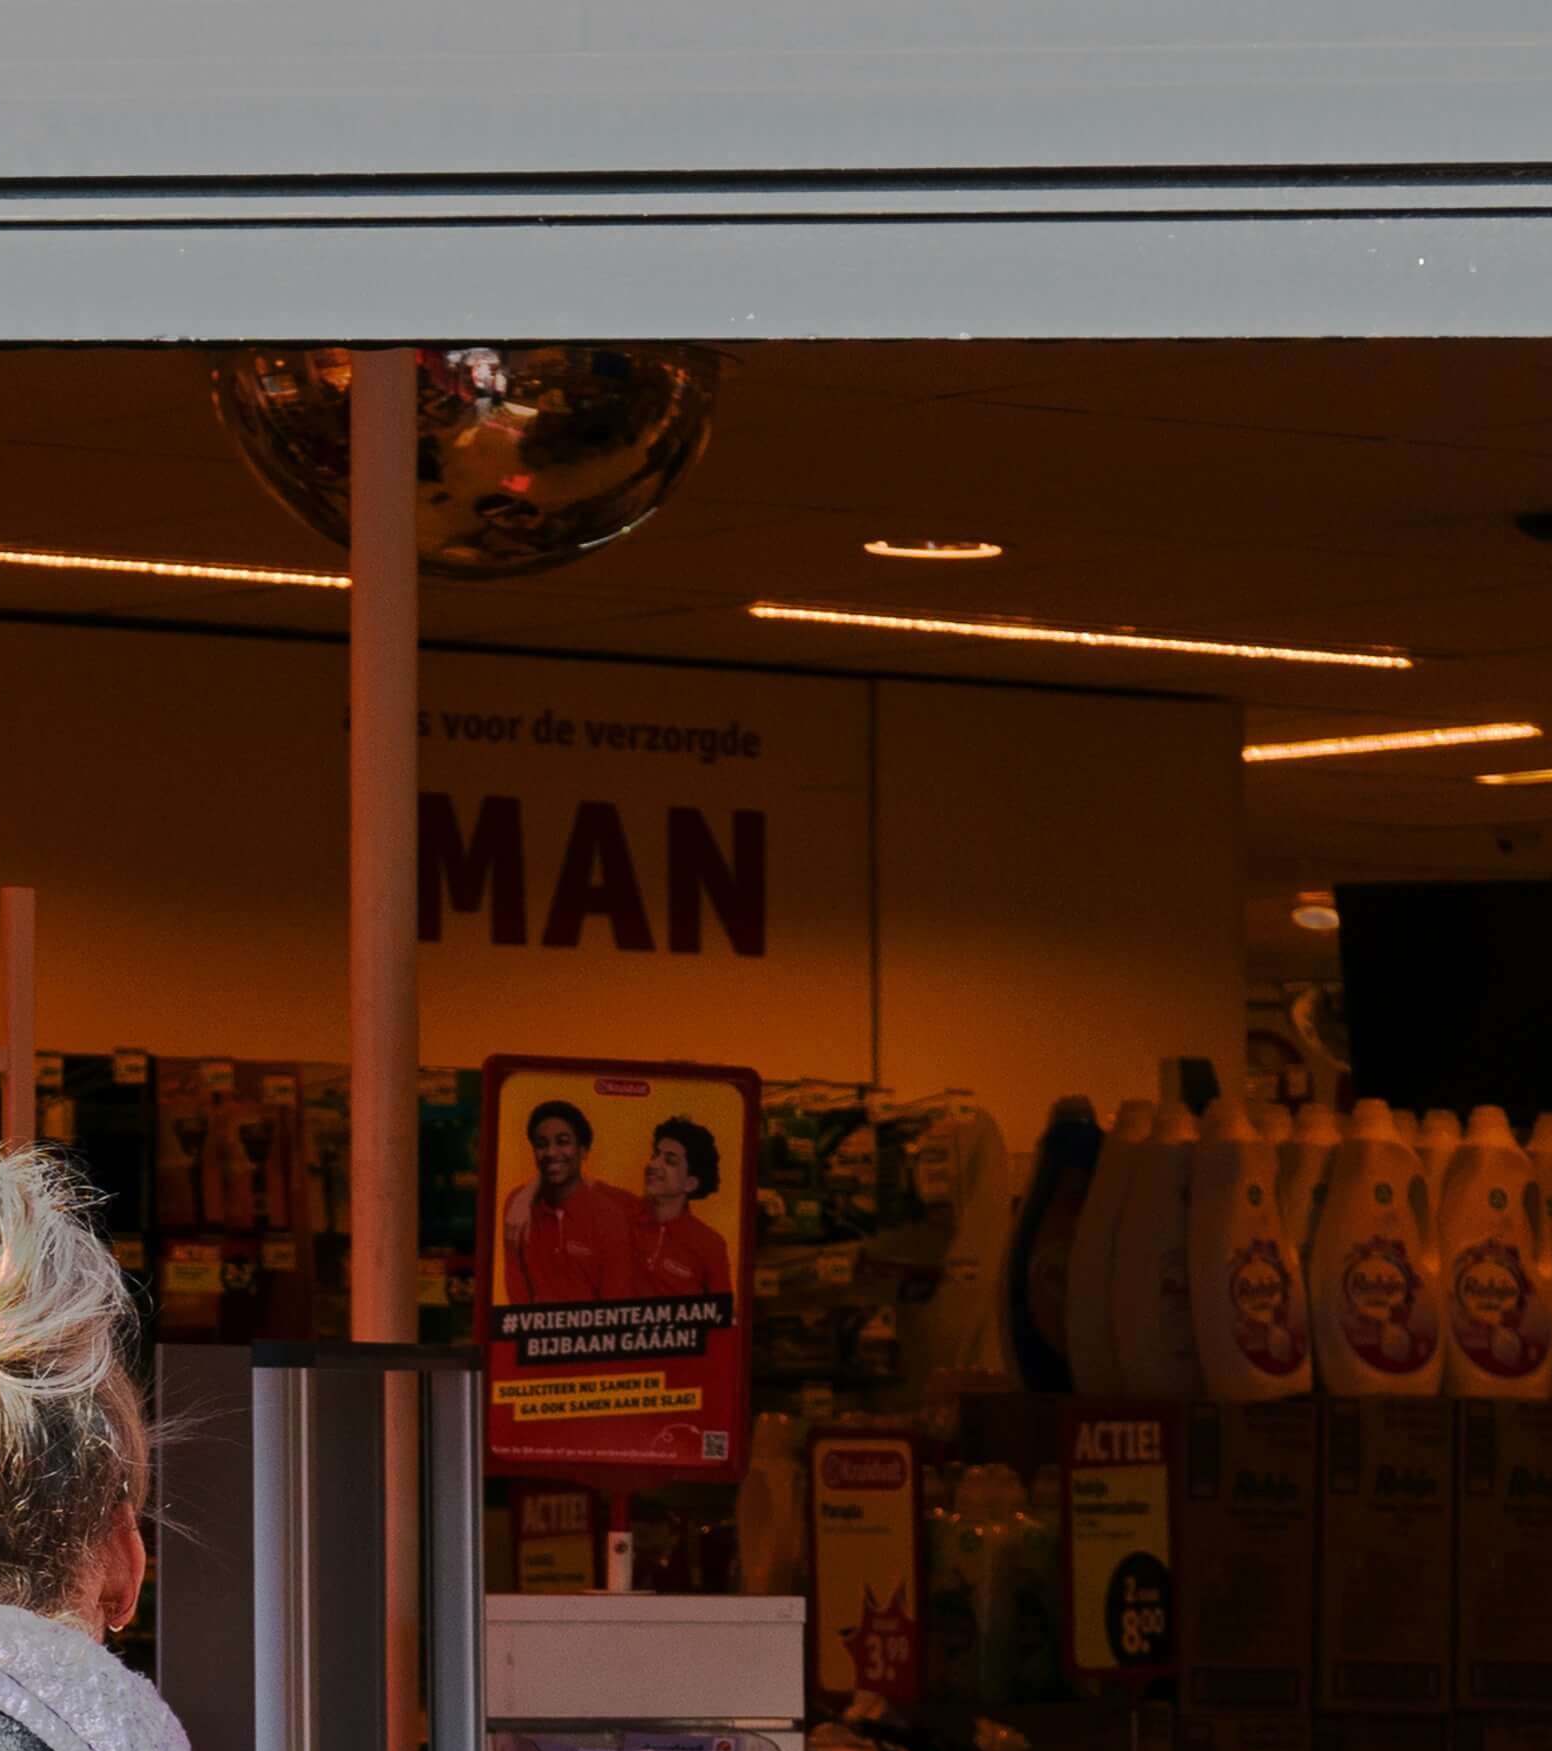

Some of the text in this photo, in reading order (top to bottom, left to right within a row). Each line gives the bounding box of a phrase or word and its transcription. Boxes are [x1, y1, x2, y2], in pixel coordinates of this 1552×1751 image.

[442, 712, 521, 742] voor
[532, 709, 576, 746] de
[586, 717, 761, 764] verzorgde
[417, 792, 767, 957] MAN
[502, 1302, 722, 1333] #VRIENDENTEAM AAN,
[527, 1325, 696, 1357] BIJBAAN GÁÁÁN!
[498, 1377, 660, 1397] SOLLICITEER NU SAMEN EN
[520, 1403, 538, 1415] GA
[541, 1401, 565, 1413] OOK
[571, 1398, 611, 1411] SAMEN
[643, 1395, 657, 1406] DE
[1072, 1419, 1162, 1462] ACTIE!
